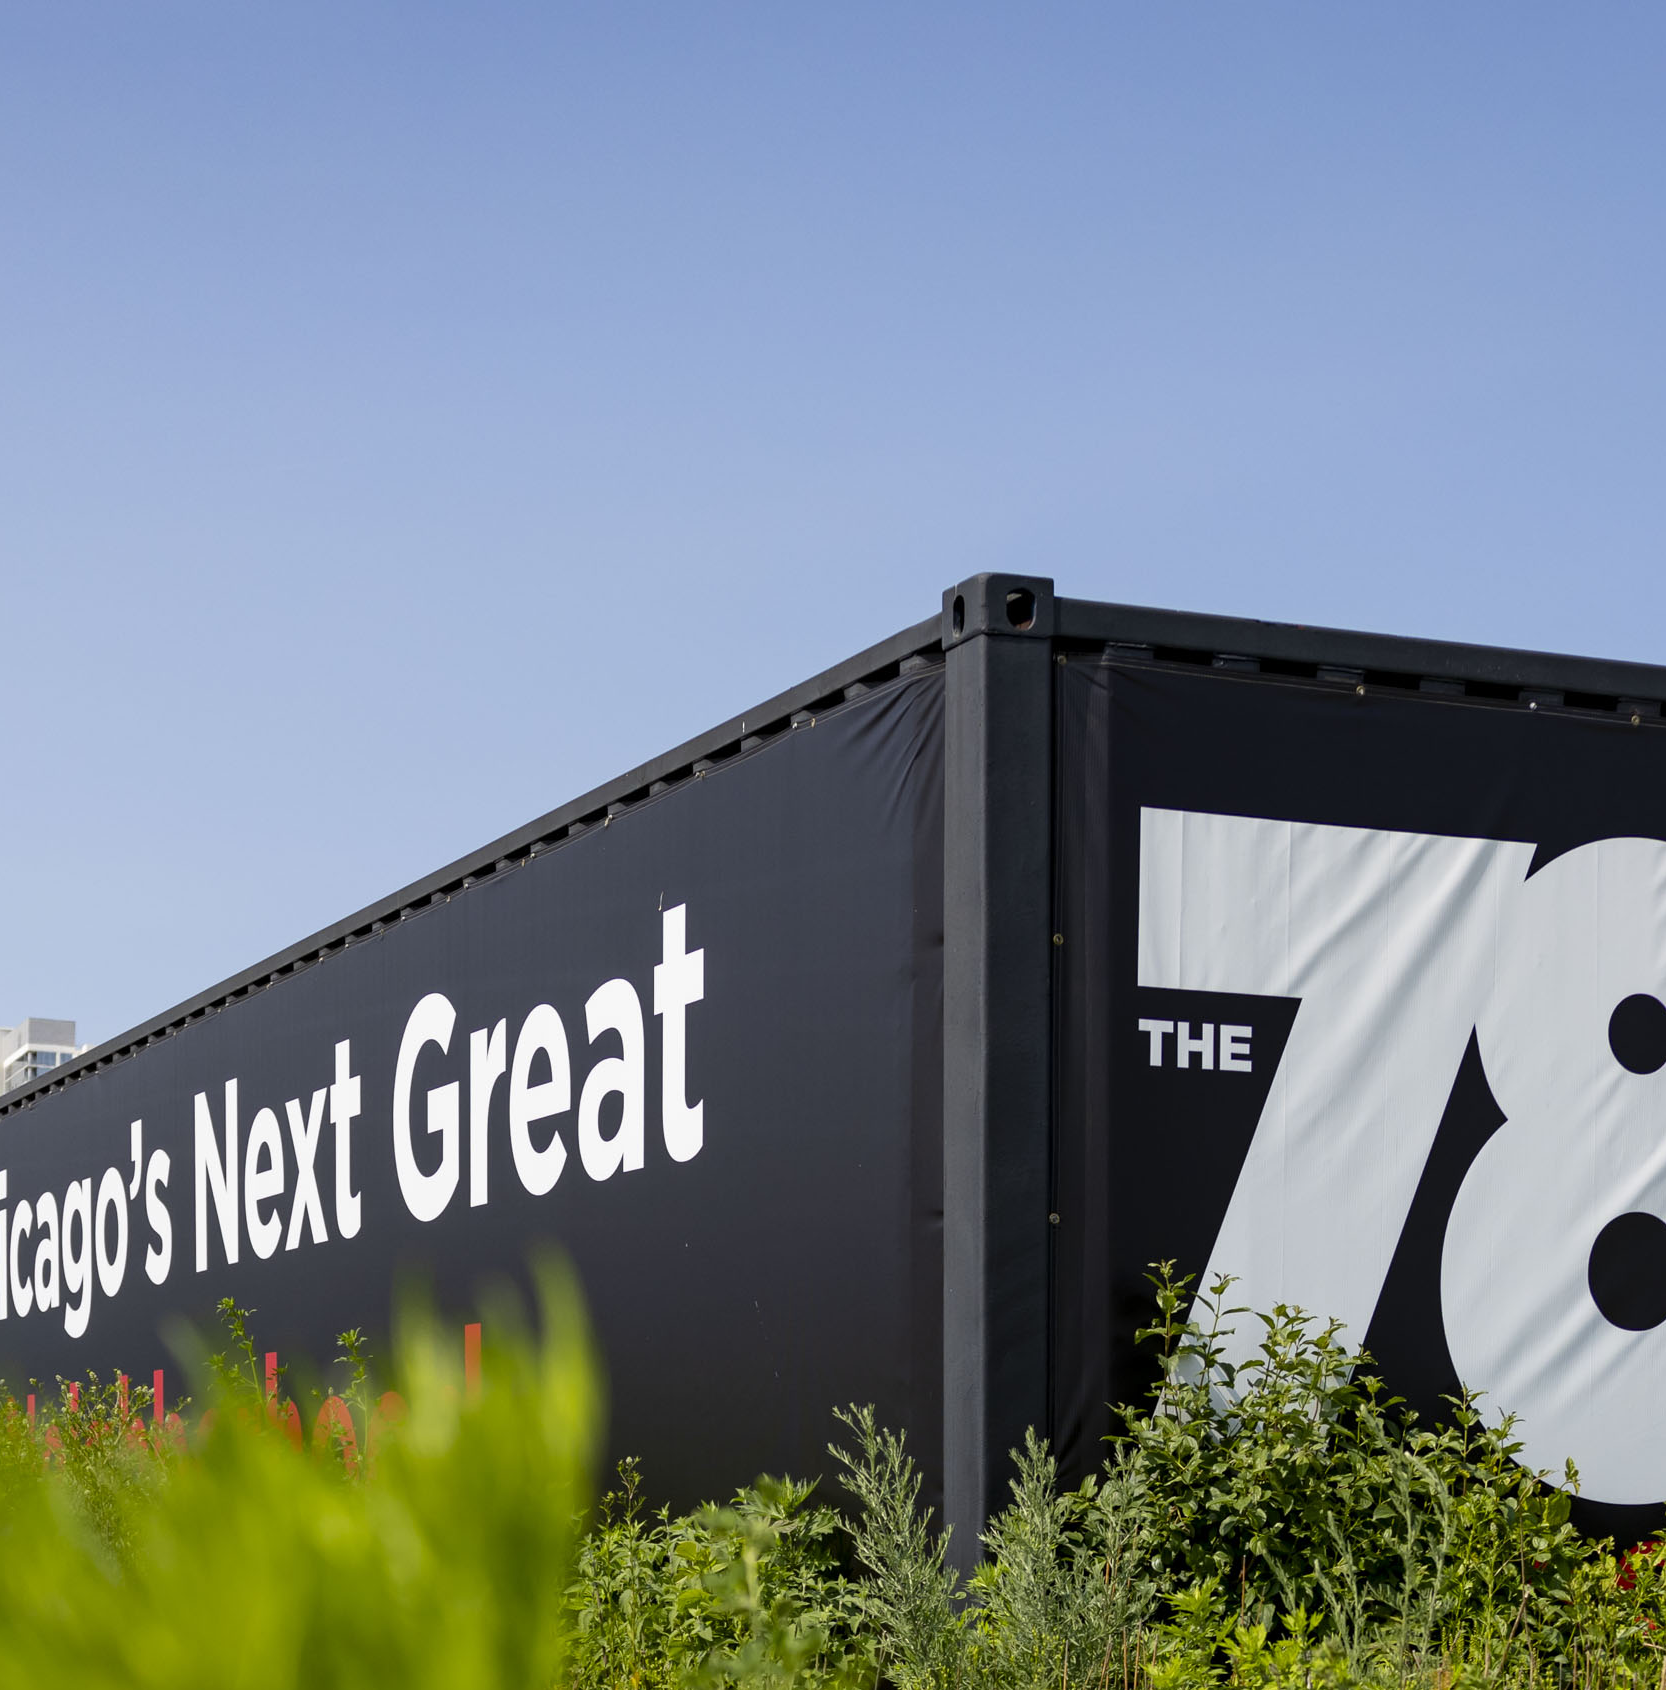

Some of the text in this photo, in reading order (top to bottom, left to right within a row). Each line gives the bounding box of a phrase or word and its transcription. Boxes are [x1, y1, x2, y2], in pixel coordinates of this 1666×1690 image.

[194, 1038, 362, 1273] Next
[393, 903, 705, 1223] Great
[1138, 1018, 1253, 1073] THE
